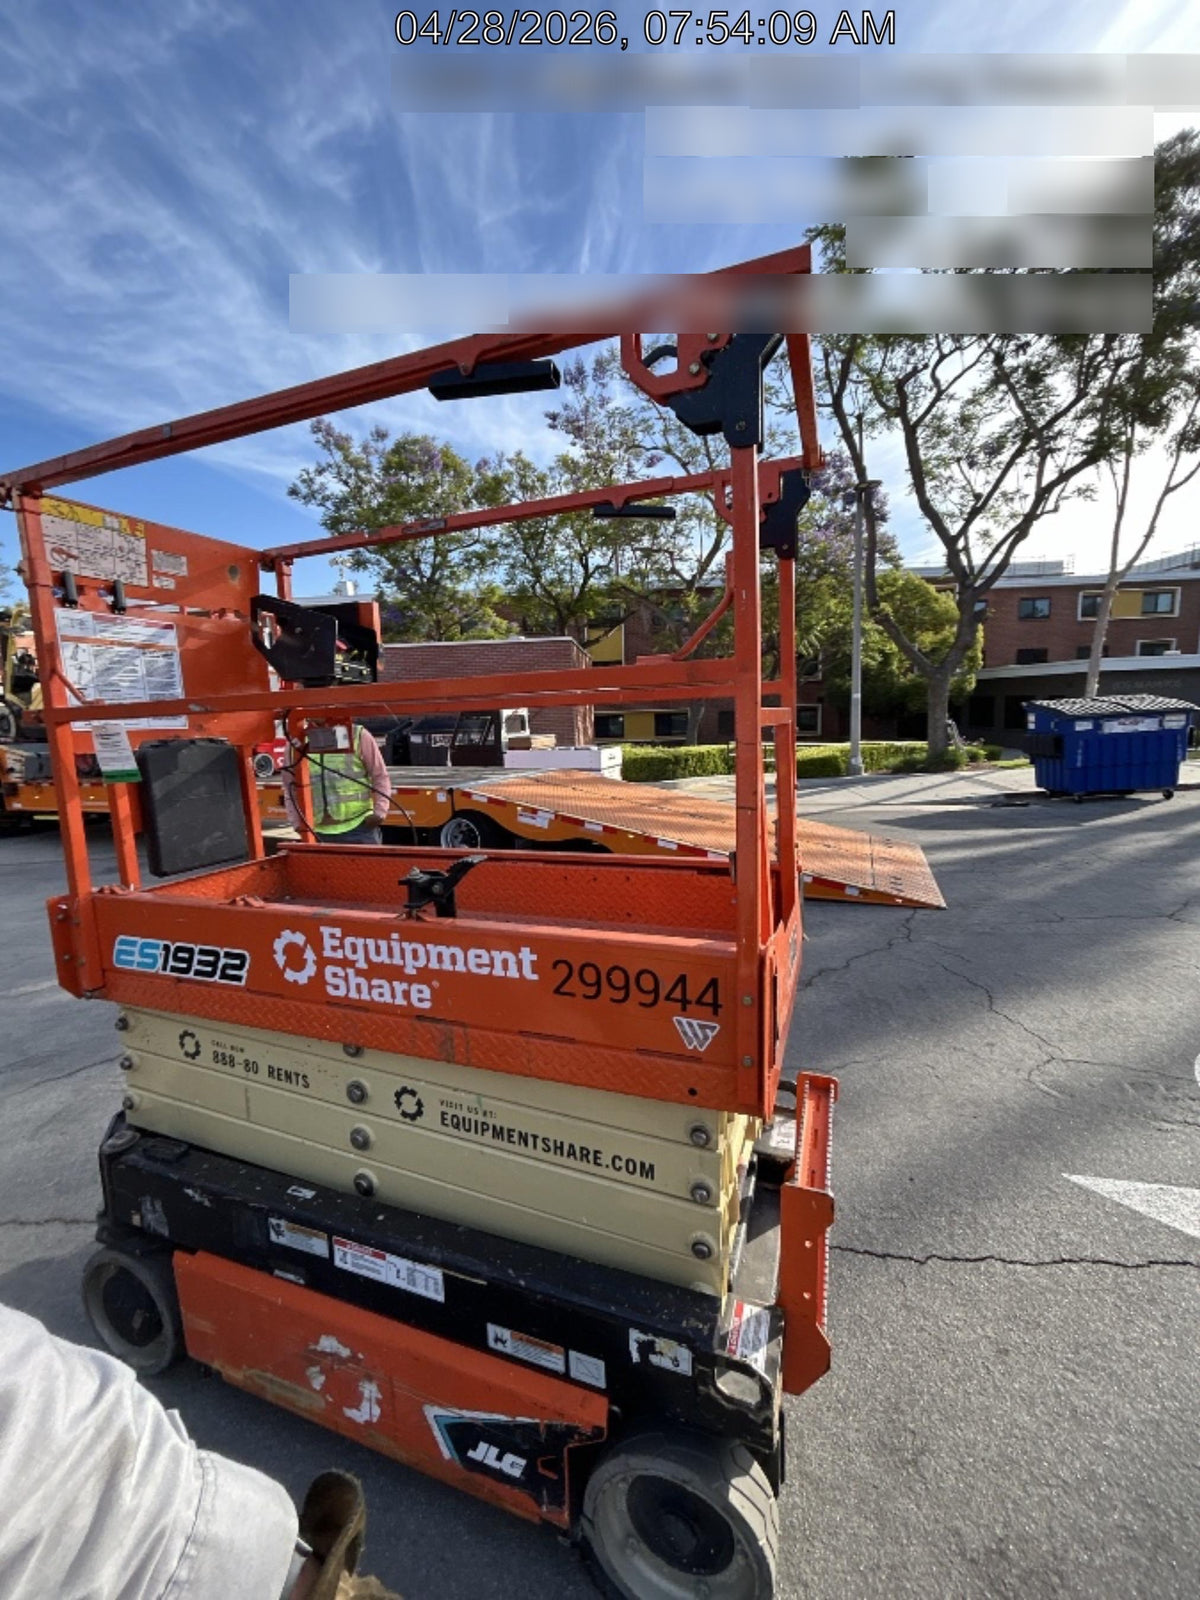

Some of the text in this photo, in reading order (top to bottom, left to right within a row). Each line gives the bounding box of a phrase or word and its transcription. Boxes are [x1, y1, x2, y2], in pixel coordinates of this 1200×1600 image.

[113, 935, 249, 985] ES1932
[320, 926, 539, 981] Equipment
[552, 959, 723, 1017] 299944
[212, 1050, 310, 1089] 888-80 RENTS
[440, 1111, 656, 1181] EQUIPMENTSHARE.COM
[467, 1441, 527, 1478] JLG
